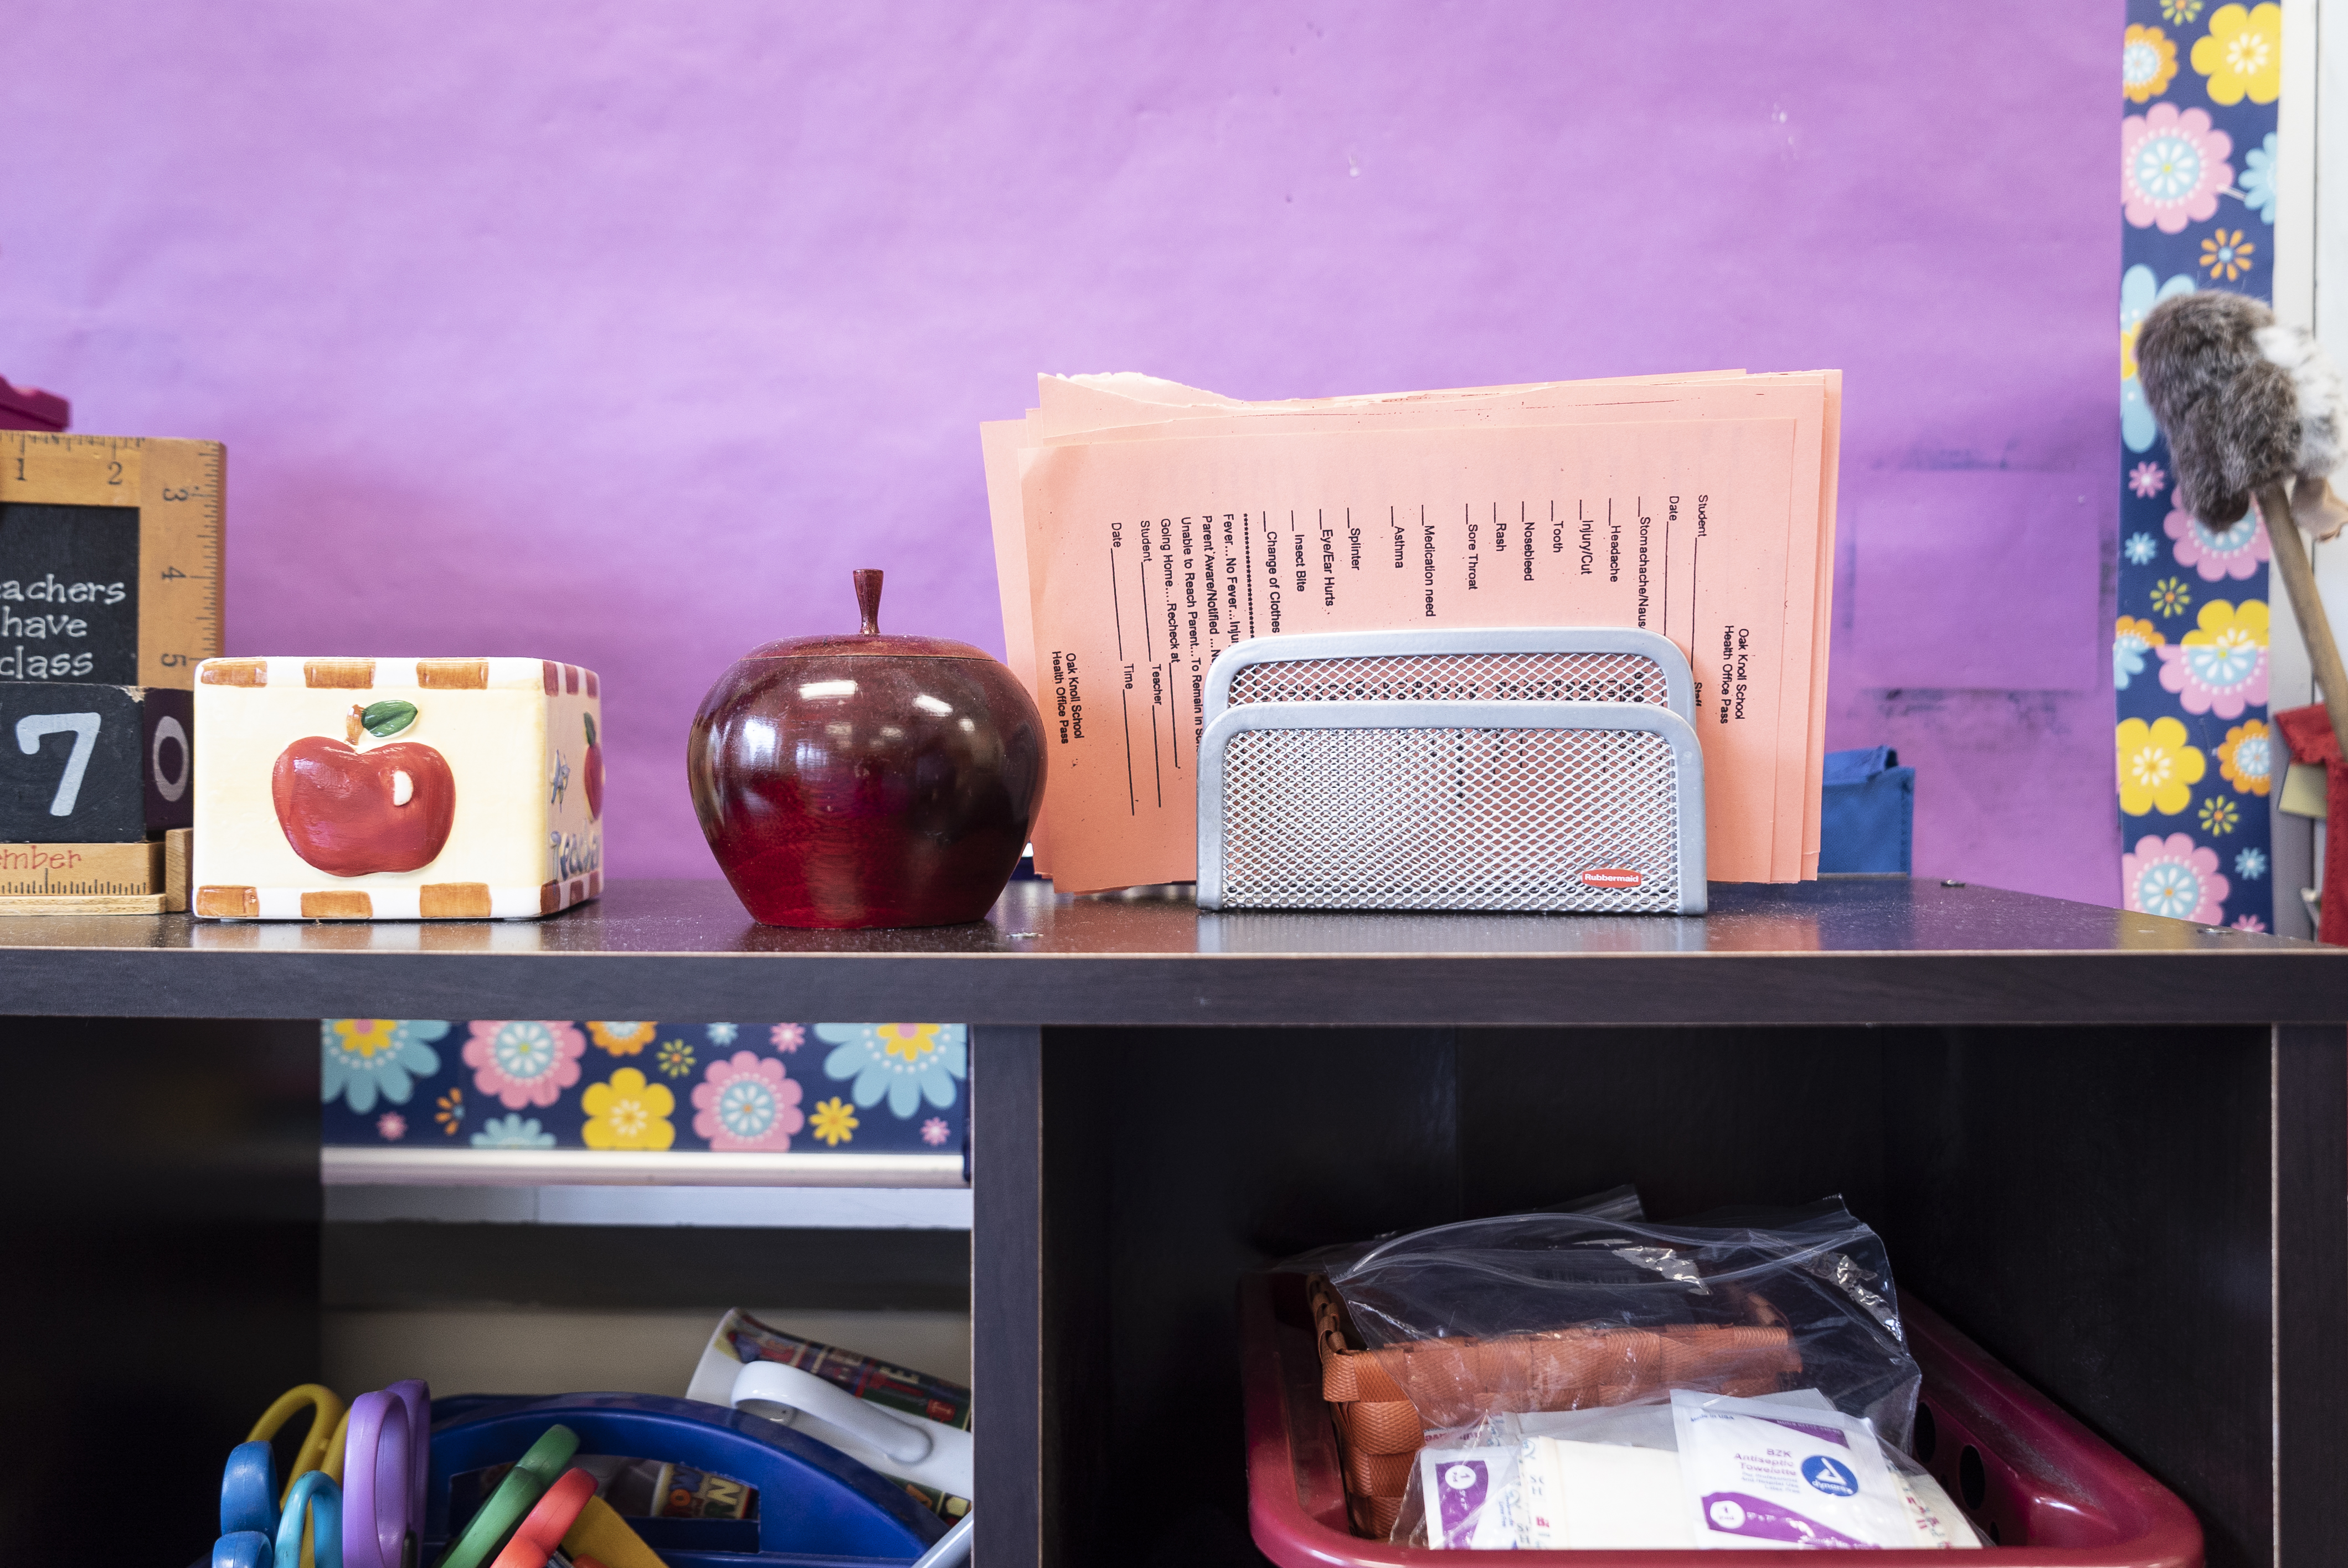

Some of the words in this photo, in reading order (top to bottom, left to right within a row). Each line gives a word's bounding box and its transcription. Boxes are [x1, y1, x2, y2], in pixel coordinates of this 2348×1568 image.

[16, 459, 27, 482] 1
[107, 462, 123, 485] 2
[163, 487, 189, 503] 3
[1669, 496, 1680, 521] Date
[1697, 494, 1708, 538] Student
[1181, 517, 1193, 555] Unable
[1202, 515, 1214, 552] Parent
[1348, 528, 1362, 571] Splinter
[1394, 526, 1405, 569] Asthma
[1468, 524, 1478, 551] Sore
[1496, 523, 1507, 552] Rash
[1553, 520, 1564, 553] Tooth
[1579, 520, 1594, 575] Injury/Cut
[1183, 558, 1194, 569] to
[1265, 531, 1278, 575] Change
[1294, 534, 1306, 568] Insect
[1320, 529, 1335, 574] Eye/Ear
[1424, 525, 1436, 586] Medication
[1523, 522, 1535, 581] Nosebleed
[1610, 525, 1621, 582] Headache
[161, 566, 186, 581] 4
[1269, 577, 1280, 589] of
[1296, 570, 1307, 592] Bite
[1468, 553, 1479, 590] Throat
[1638, 517, 1651, 630] Stomachache/Naus
[0, 573, 126, 605] achers
[1111, 522, 1122, 548] Date
[1124, 663, 1135, 689] Time
[1160, 518, 1172, 551] Going
[1170, 652, 1181, 663] at
[1185, 572, 1197, 608] Reach
[1204, 554, 1220, 635] Aware/Notified
[1324, 576, 1336, 607] Hurts
[1425, 589, 1436, 617] need
[1, 605, 87, 639] have
[1140, 520, 1152, 563] Student
[1152, 663, 1163, 706] Teacher
[1269, 591, 1281, 633] Clothes
[1723, 625, 1734, 660] Health
[1738, 628, 1749, 651] Oak
[160, 653, 186, 667] 5
[1052, 651, 1065, 684] Health
[1065, 653, 1078, 674] Oak
[1737, 654, 1748, 680] Knoll
[1068, 677, 1081, 703] Knoll
[1192, 674, 1203, 714] Remain
[1721, 663, 1733, 695] Office
[1055, 687, 1068, 717] Office
[1720, 699, 1732, 724] Pass
[1734, 684, 1747, 720] School
[1059, 719, 1069, 744] Pass
[1071, 704, 1085, 739] School
[16, 712, 102, 817] 7
[1584, 873, 1639, 883] Rubbermaid
[1734, 1452, 1794, 1467] Antiseptic
[1741, 1462, 1796, 1477] Towelette
[1767, 1448, 1791, 1458] BZK
